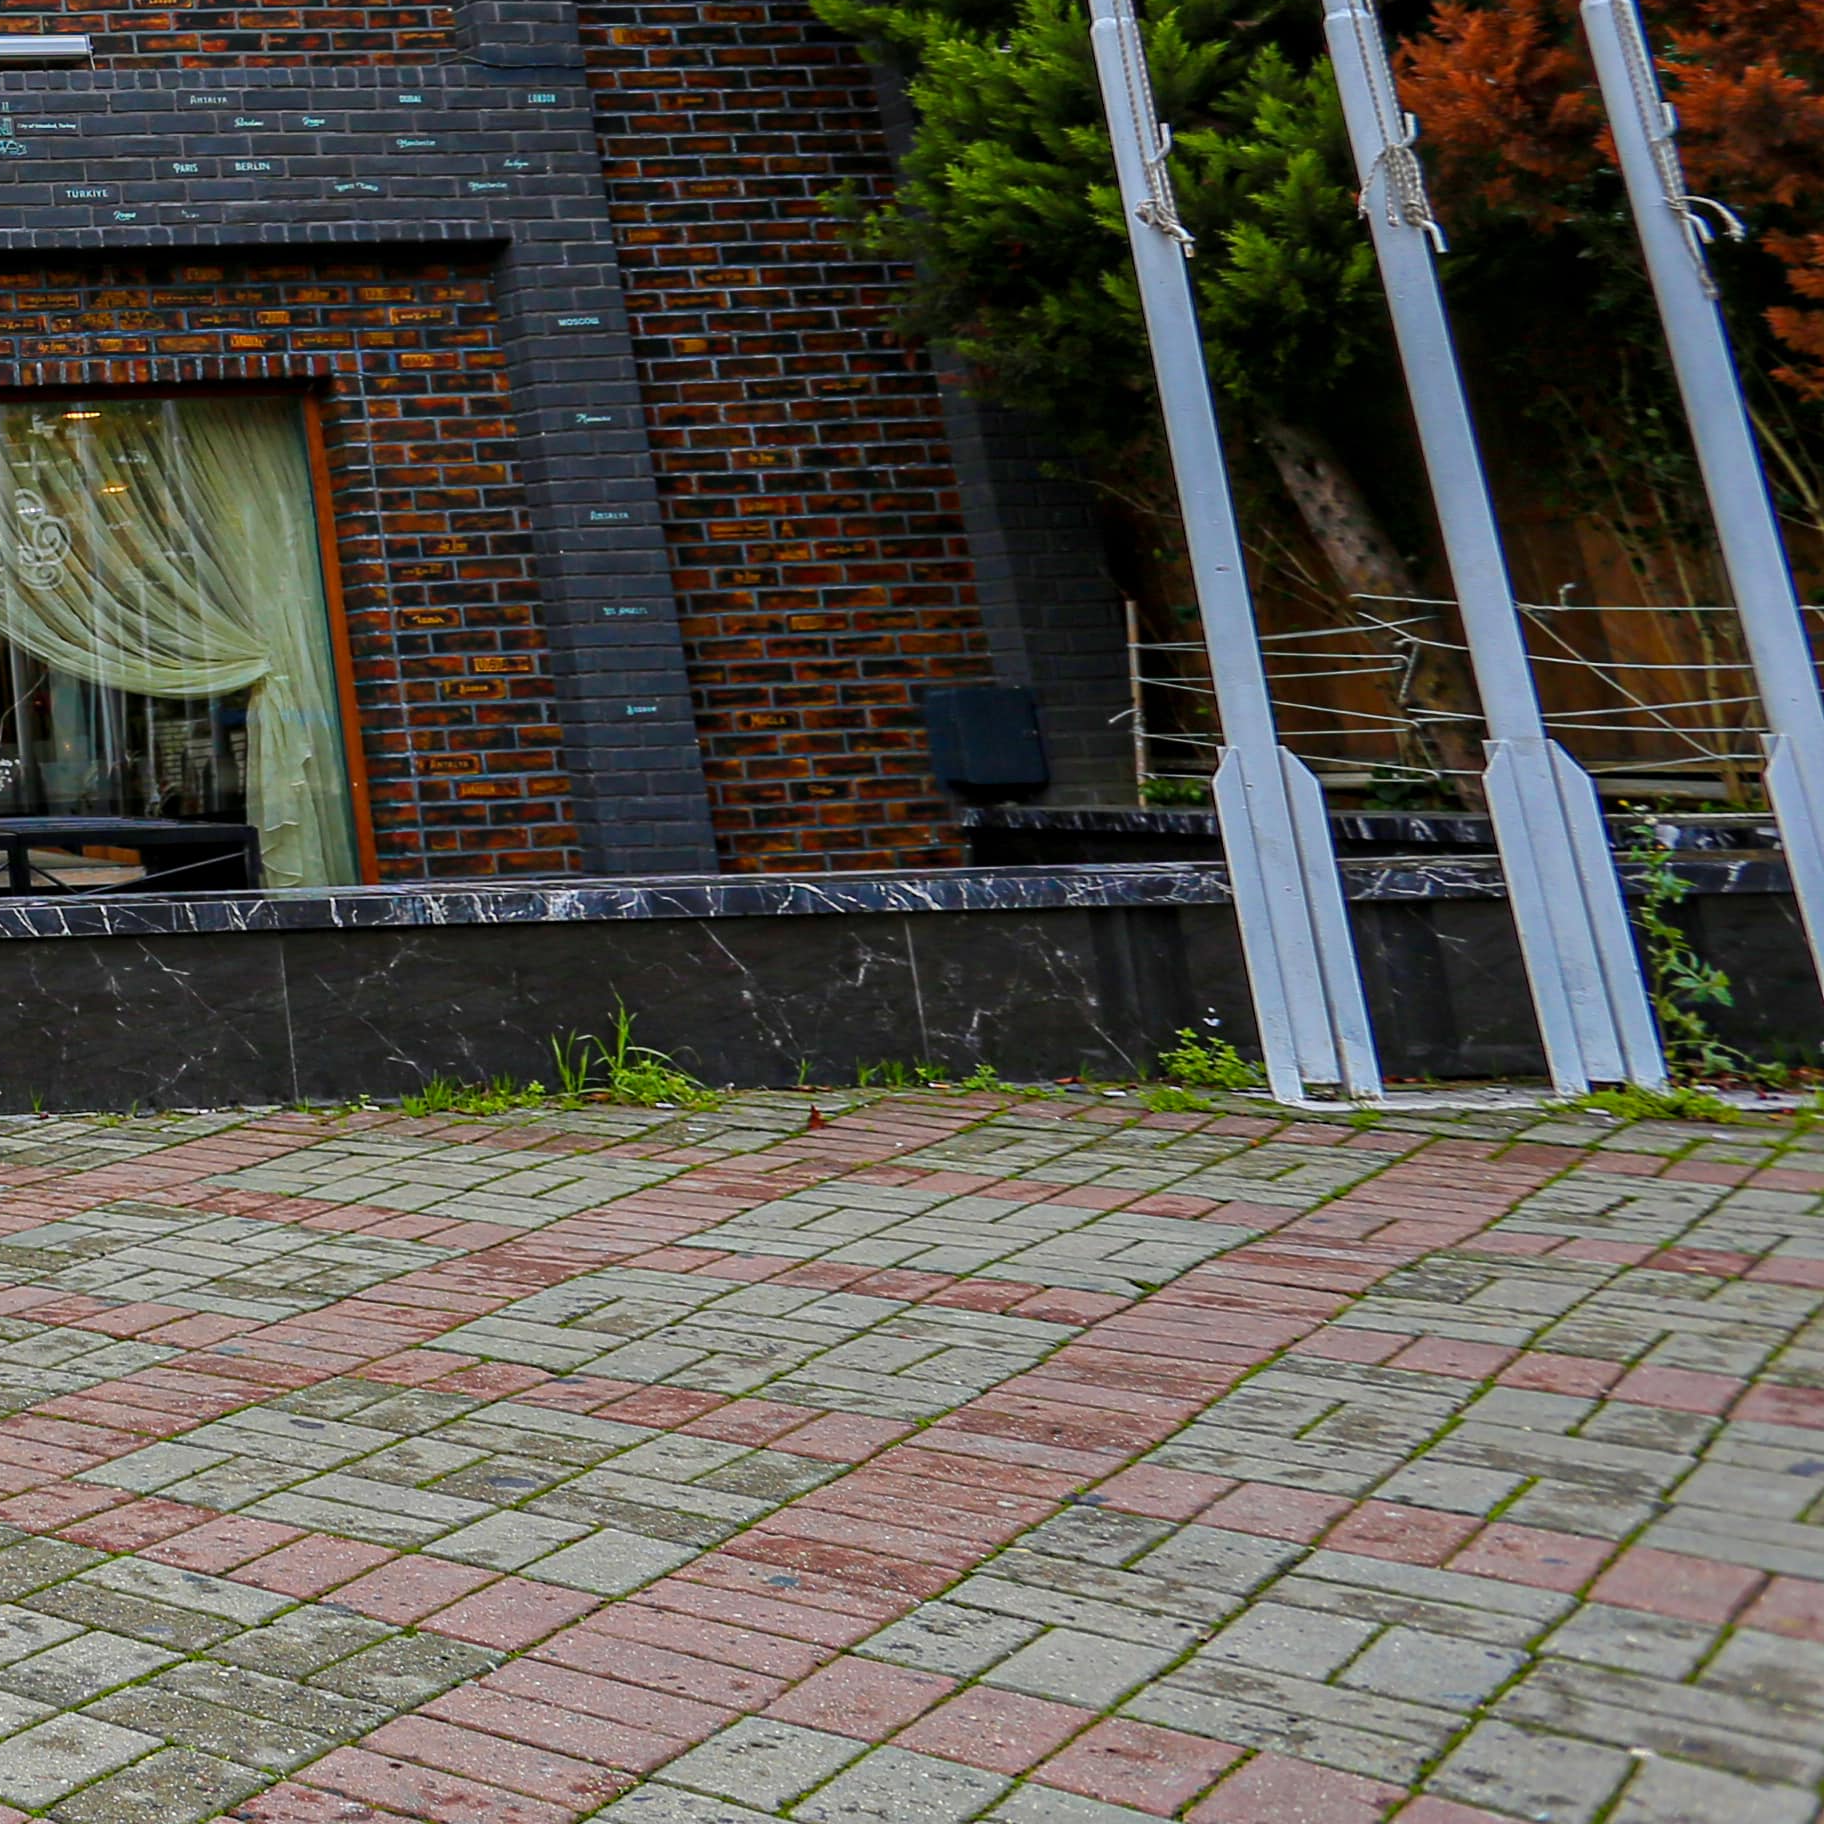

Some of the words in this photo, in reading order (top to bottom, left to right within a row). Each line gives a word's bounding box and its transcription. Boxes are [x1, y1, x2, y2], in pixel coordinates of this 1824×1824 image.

[527, 93, 556, 104] LONDON
[173, 162, 199, 173] PARIS
[234, 162, 271, 171] BERLIN
